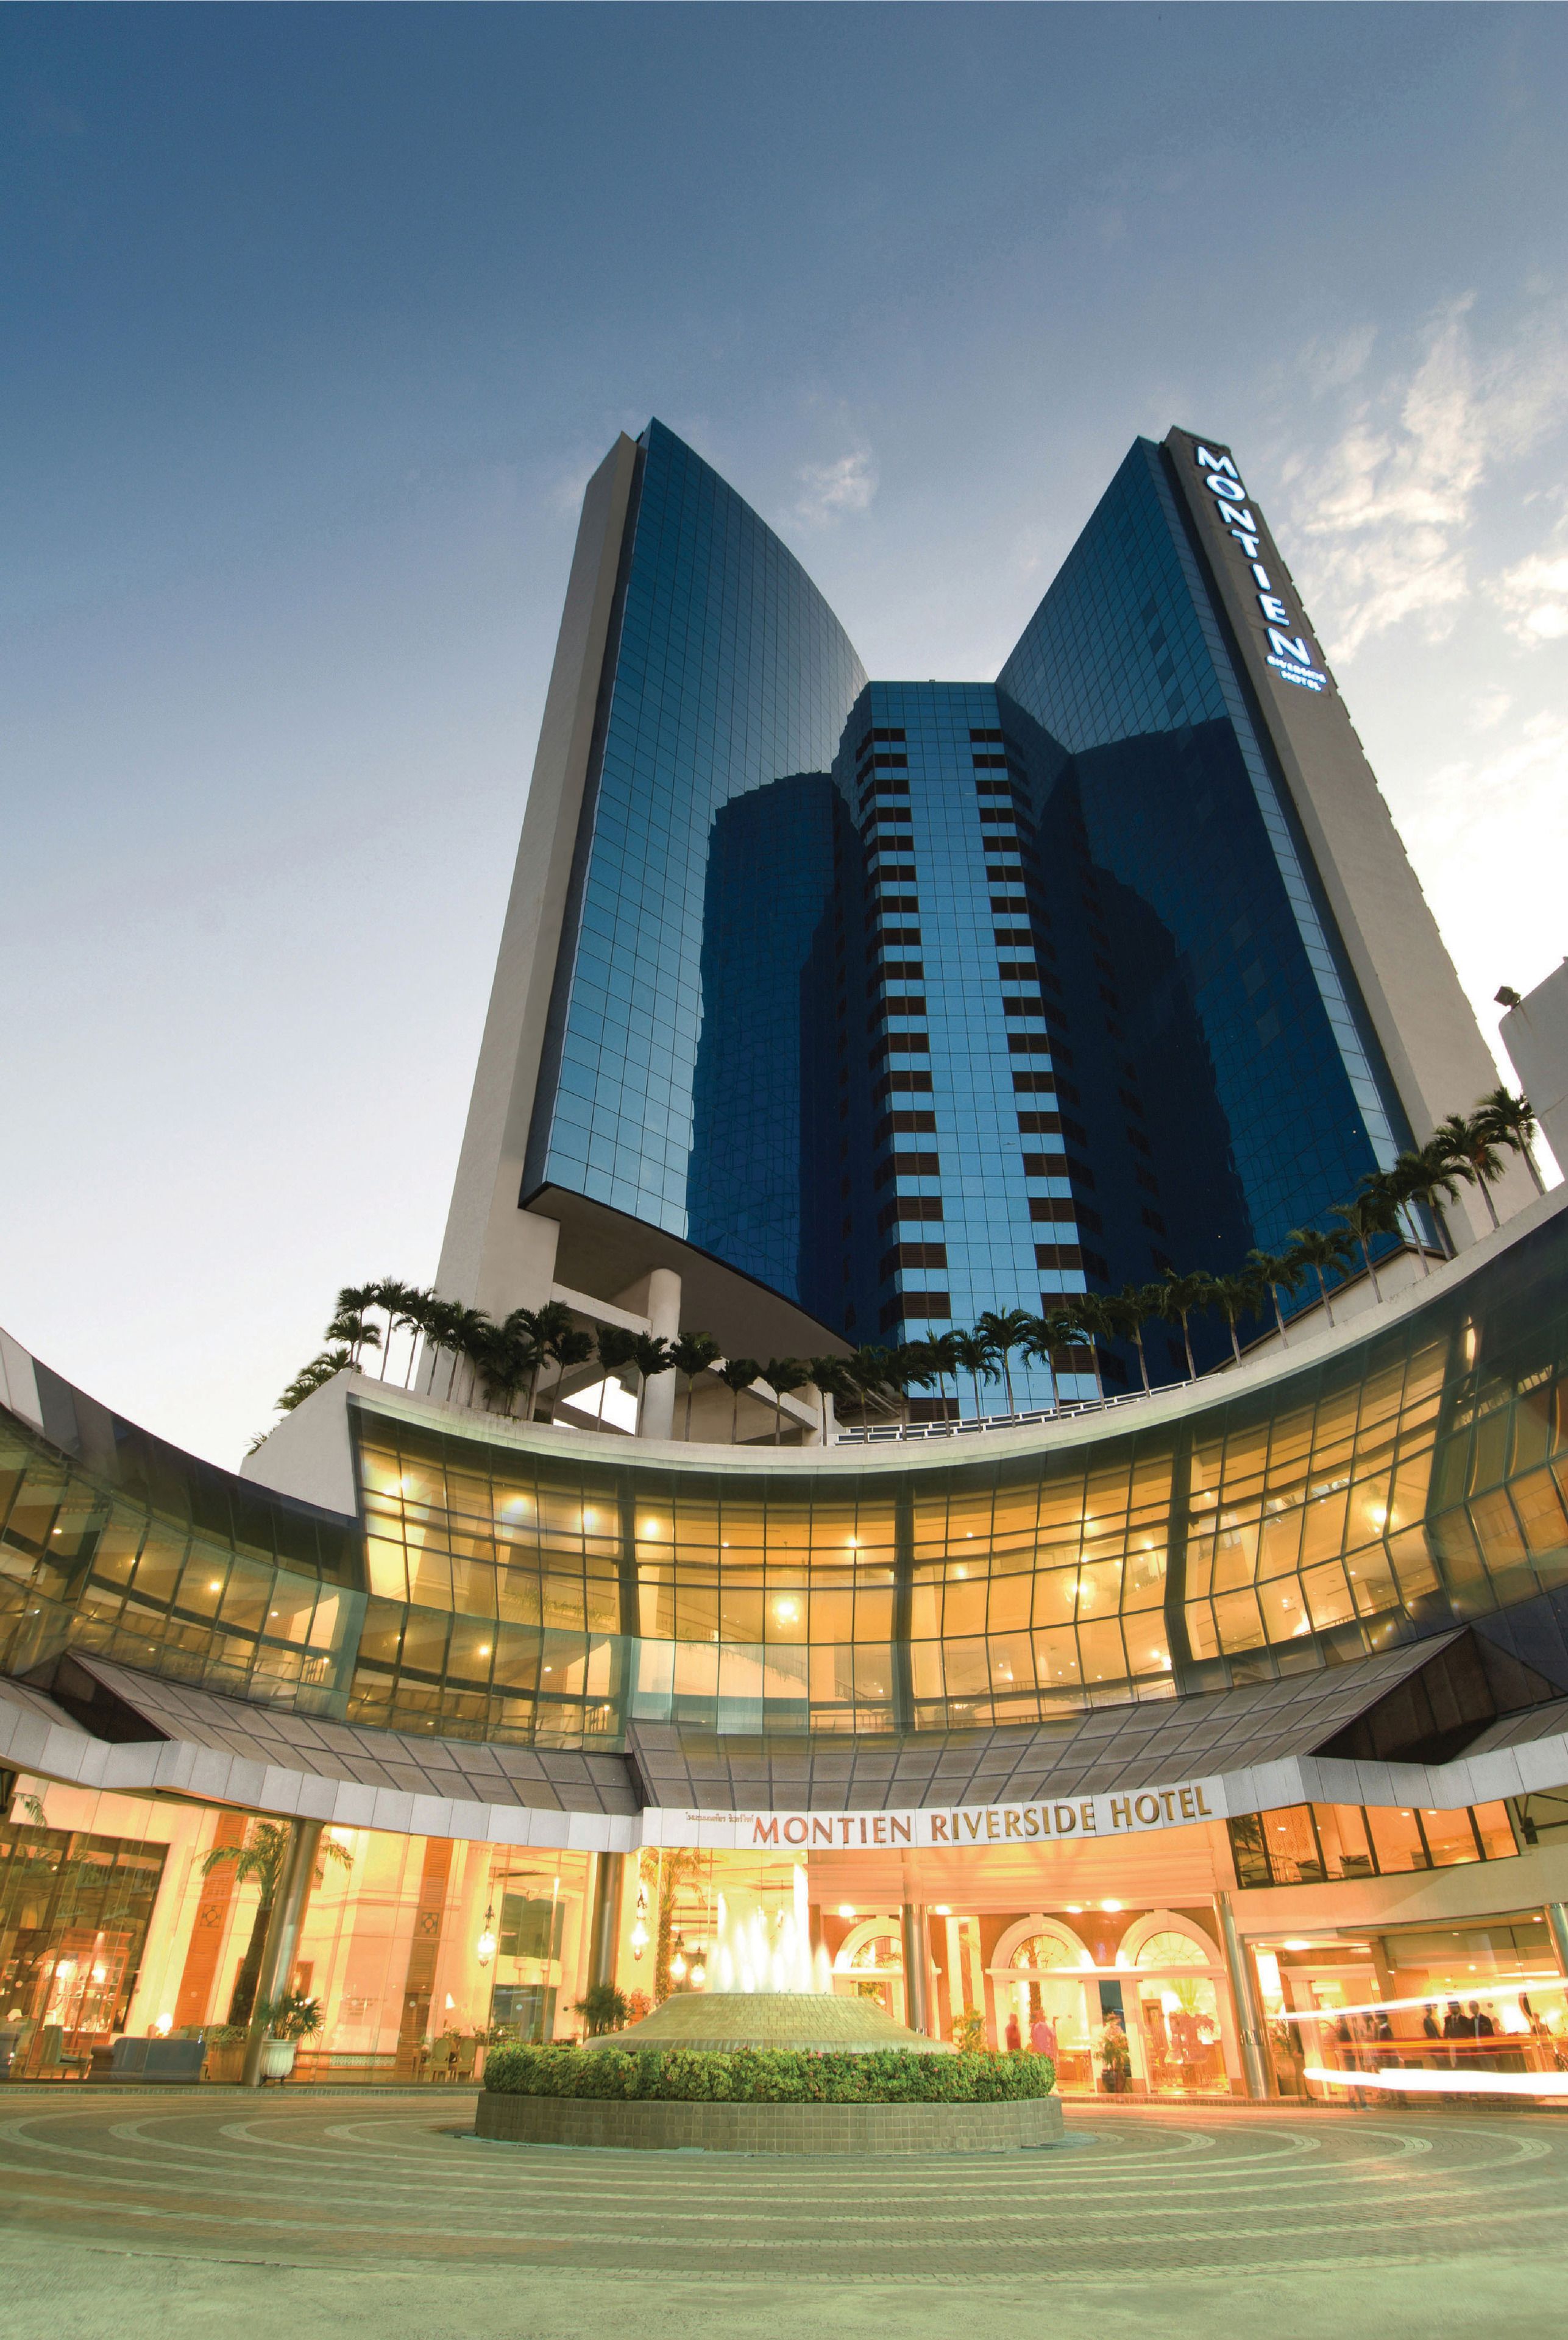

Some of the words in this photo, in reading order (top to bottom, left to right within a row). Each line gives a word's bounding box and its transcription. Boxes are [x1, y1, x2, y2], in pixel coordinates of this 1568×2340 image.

[1196, 446, 1310, 665] MONTIEN
[753, 1816, 910, 1843] MONTIEN
[931, 1803, 1094, 1841] RIVERSIDE
[1110, 1785, 1212, 1827] HOTEL
